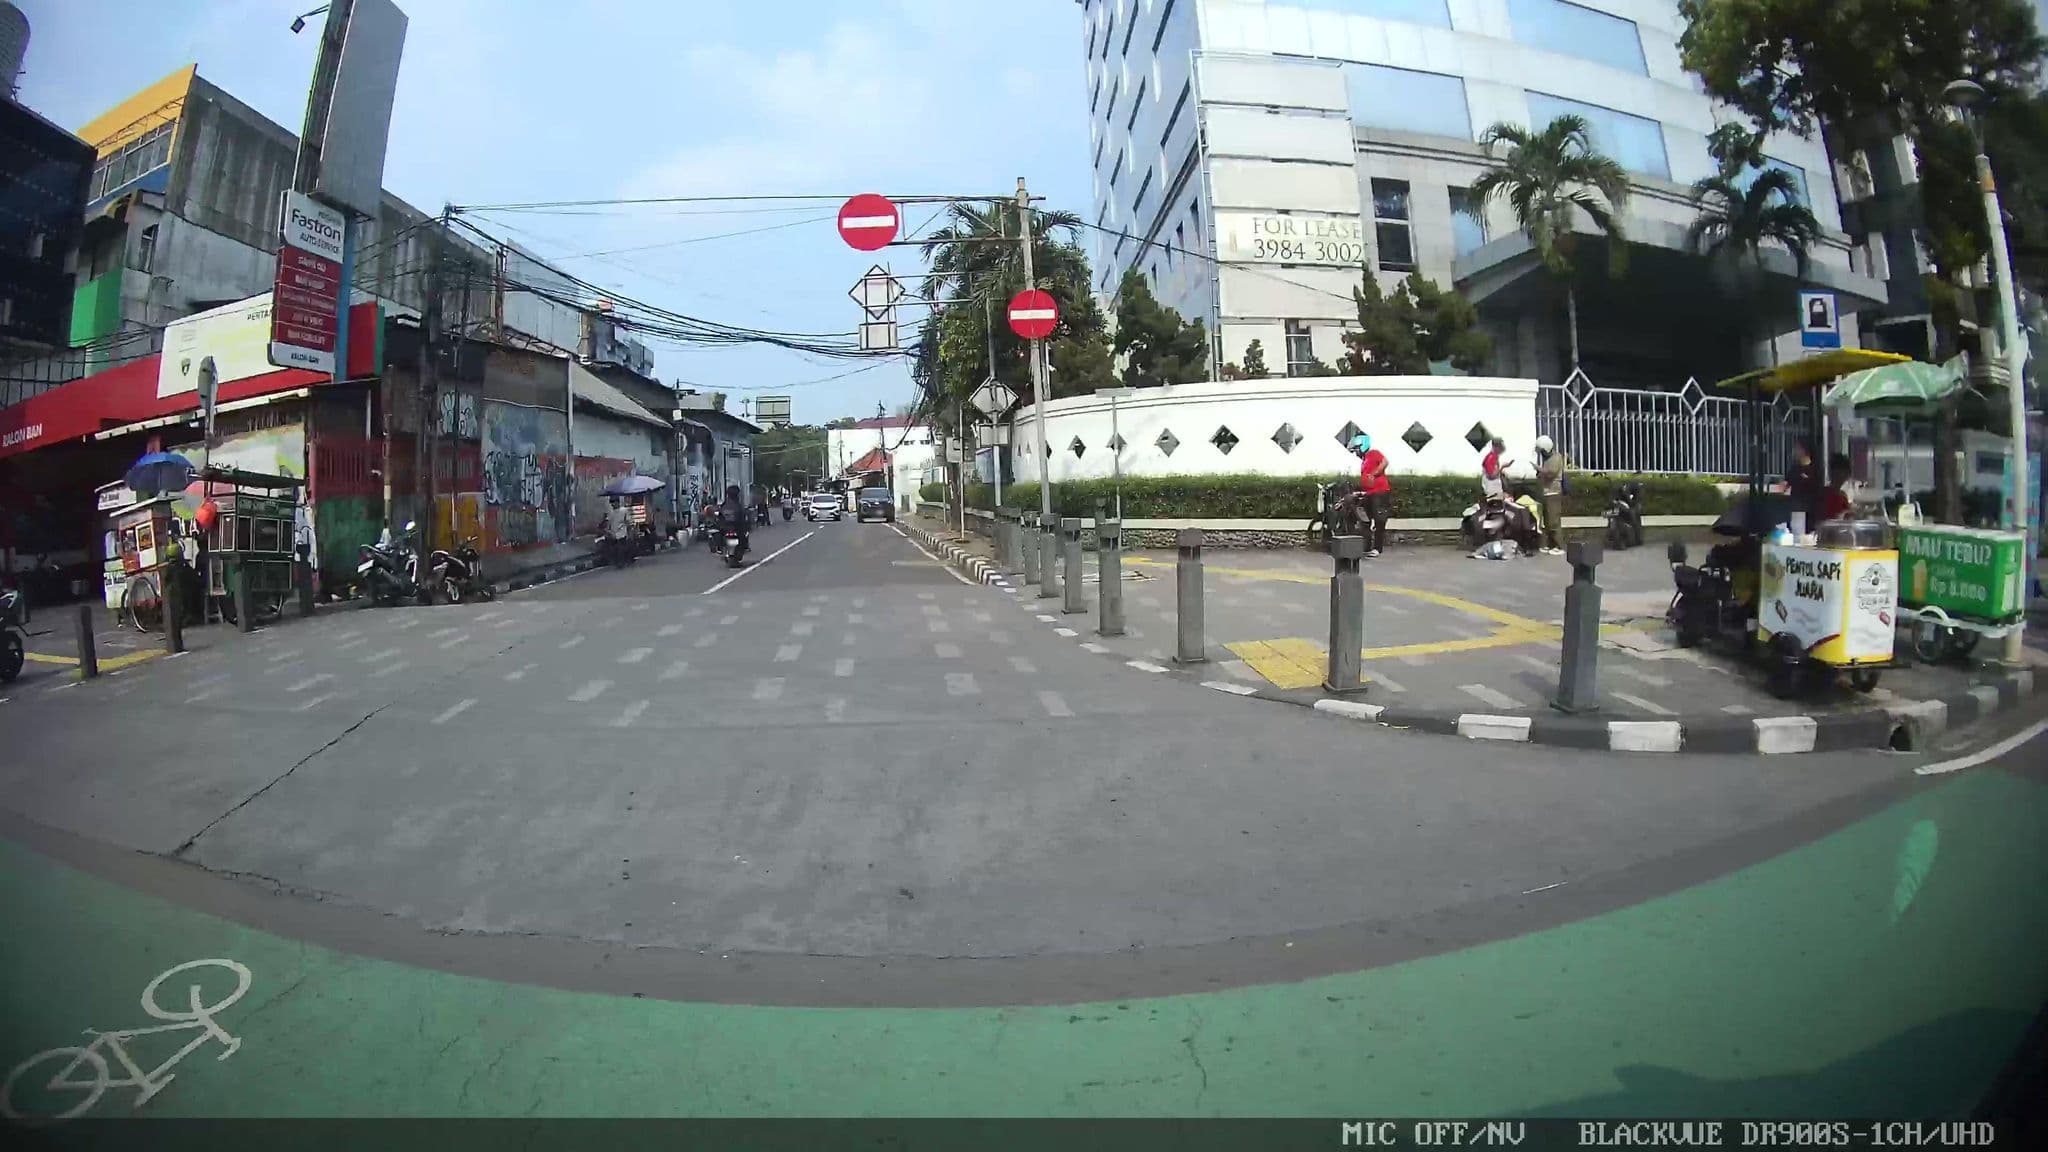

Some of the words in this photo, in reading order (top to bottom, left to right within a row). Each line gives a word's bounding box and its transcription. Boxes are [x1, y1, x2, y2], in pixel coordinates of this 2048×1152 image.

[292, 208, 341, 241] Fastron
[1253, 217, 1297, 236] FOR
[1304, 220, 1361, 240] LEASE
[1253, 238, 1306, 260] 3984
[1314, 241, 1363, 263] 3002
[1905, 535, 1942, 558] MAU
[1795, 579, 1825, 602] JUARA
